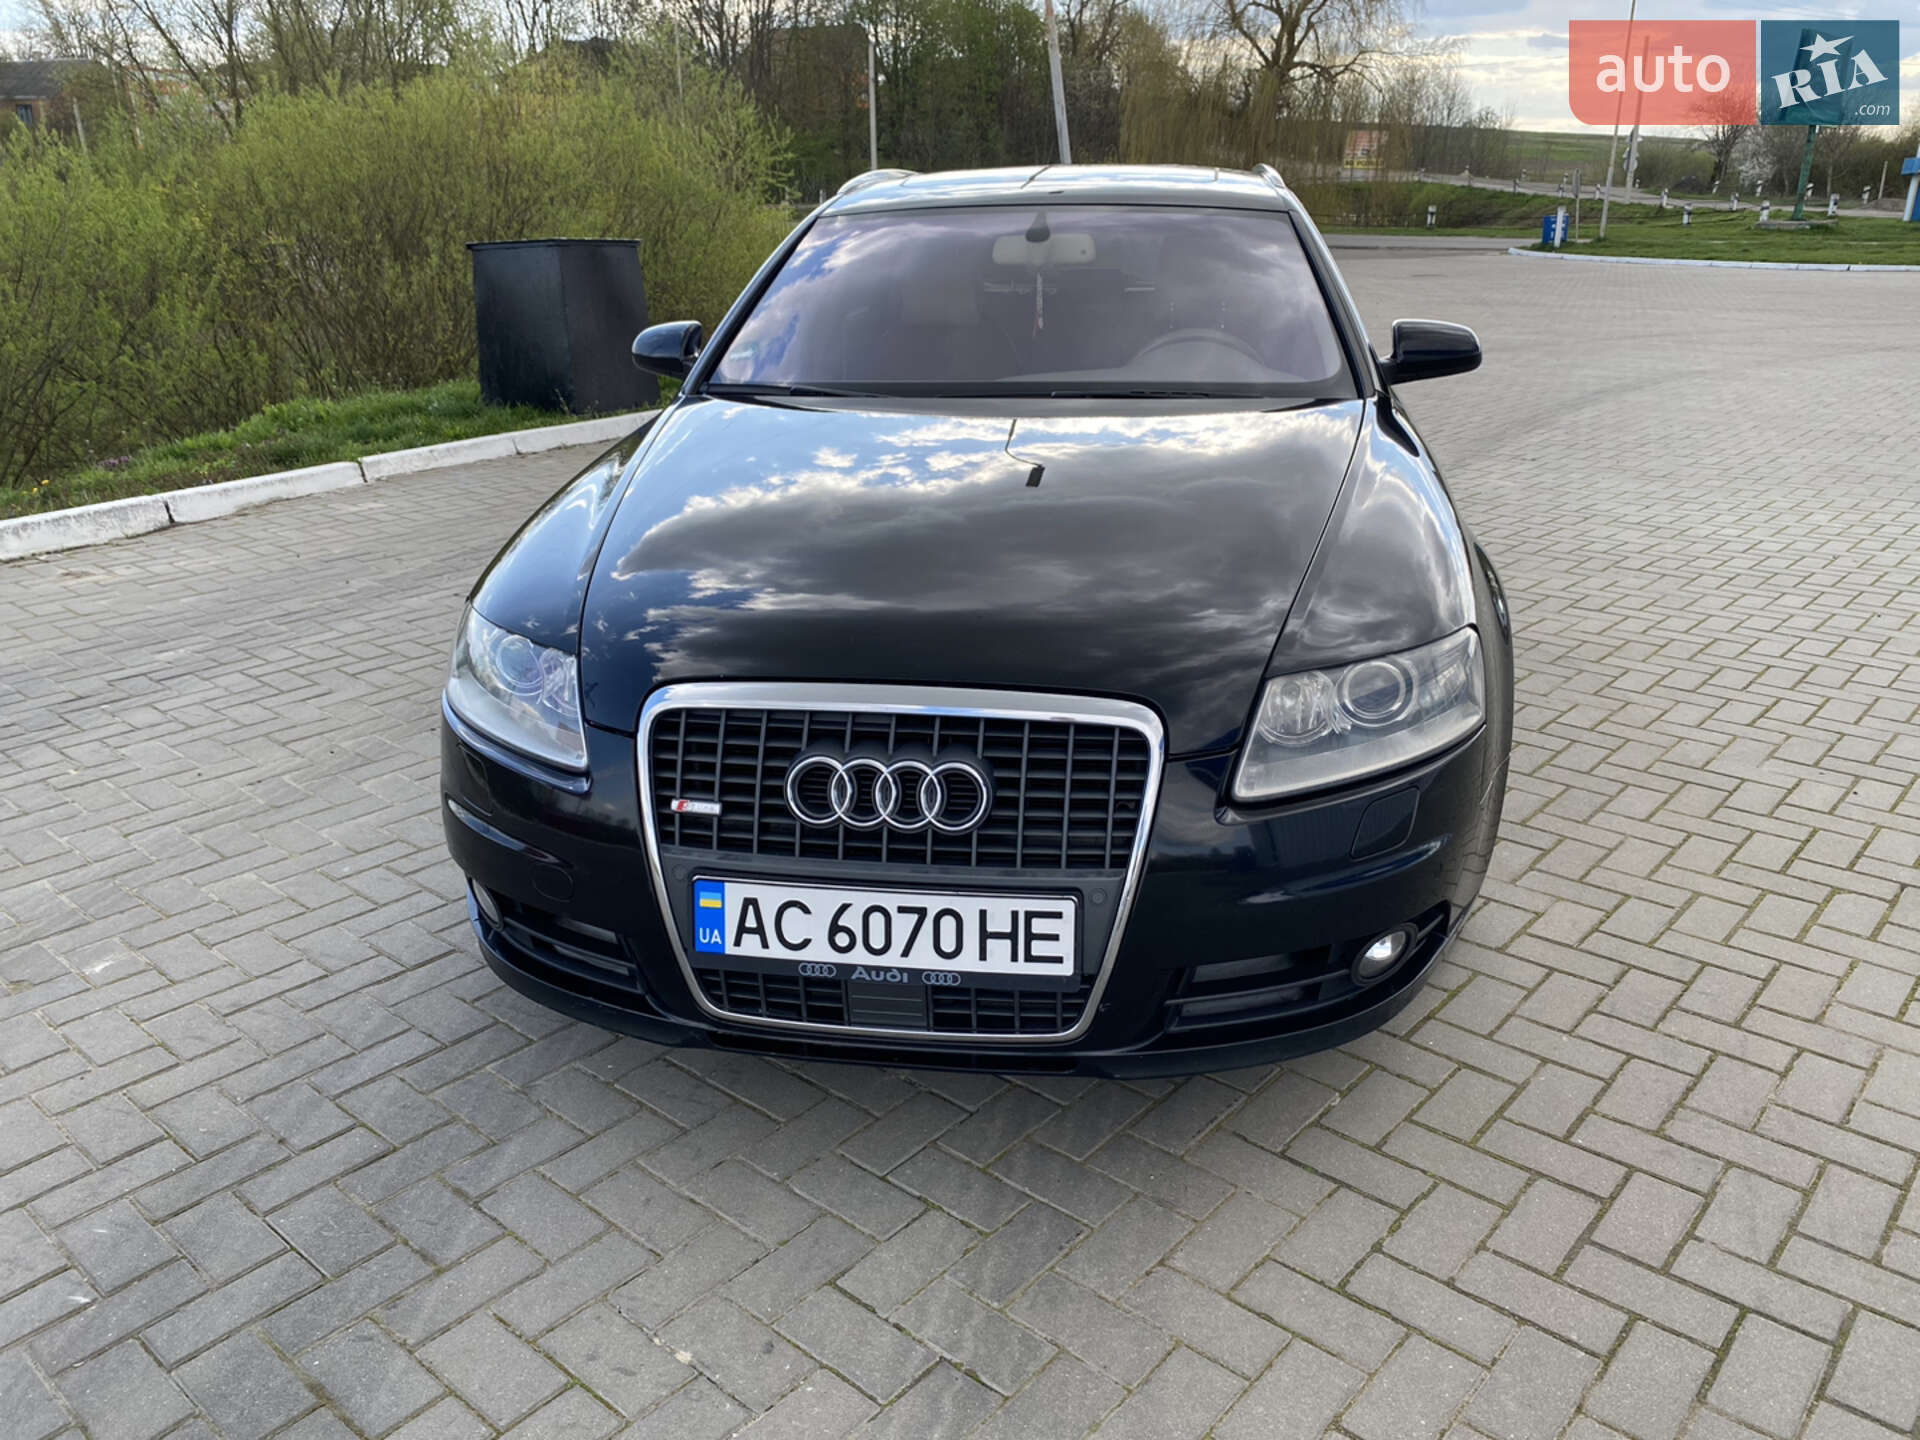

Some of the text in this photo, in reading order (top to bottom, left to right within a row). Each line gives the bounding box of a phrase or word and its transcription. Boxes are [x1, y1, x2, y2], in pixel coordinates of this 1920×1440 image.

[699, 927, 722, 945] UA
[733, 897, 1064, 964] AC 6070 HE
[851, 966, 909, 983] Audi
